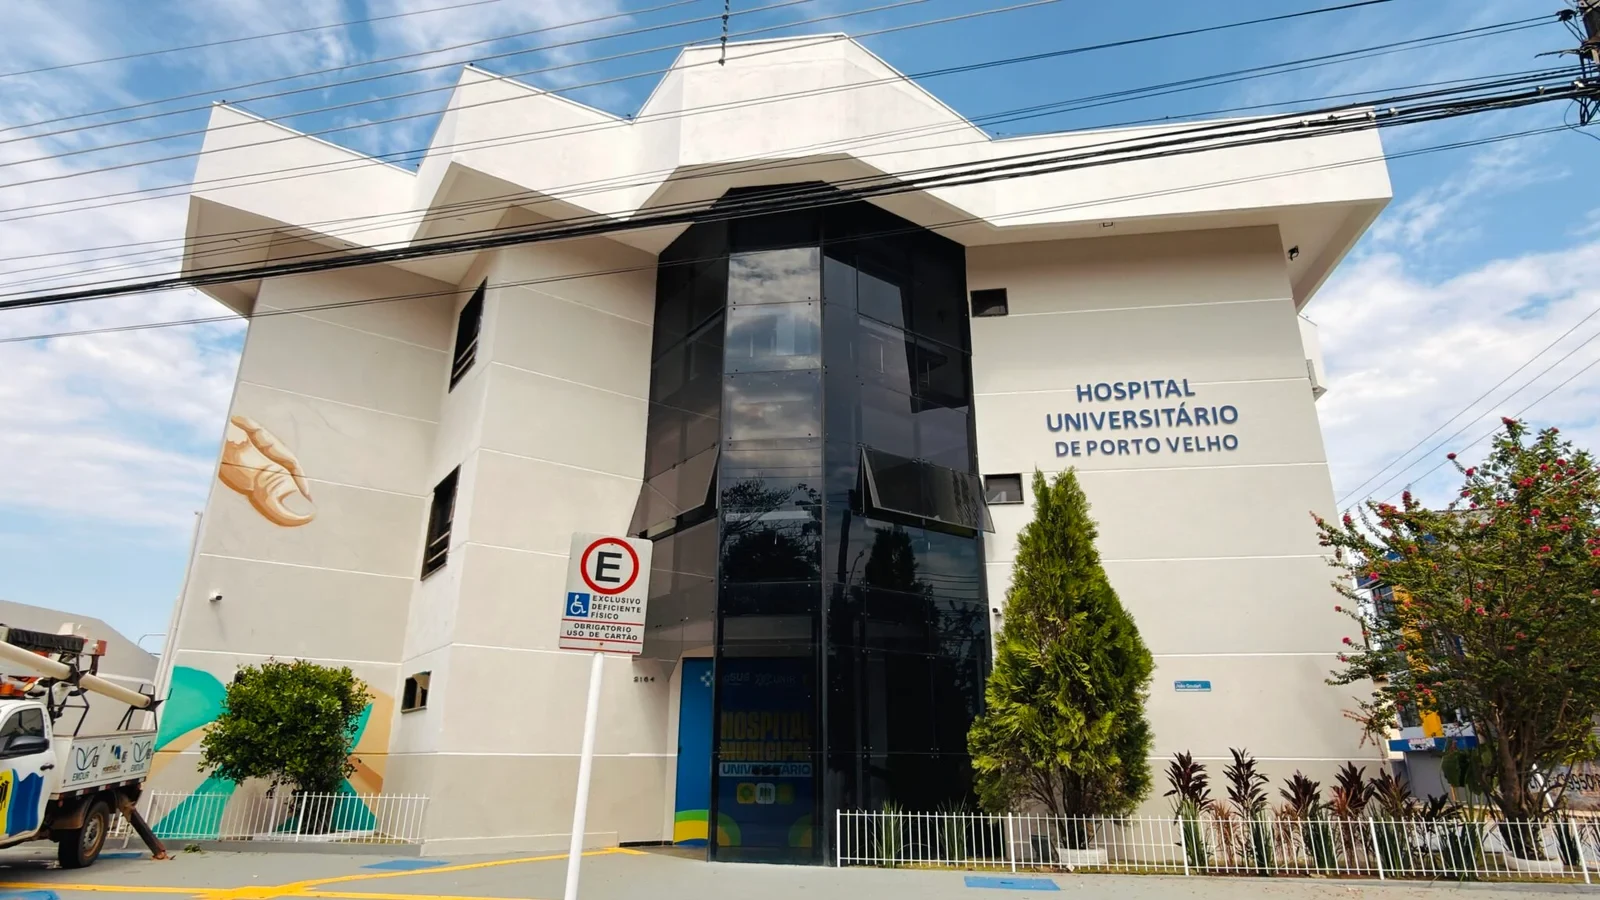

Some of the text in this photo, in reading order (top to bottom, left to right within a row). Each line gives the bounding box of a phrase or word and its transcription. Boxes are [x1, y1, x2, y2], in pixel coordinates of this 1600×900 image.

[1076, 379, 1195, 402] HOSPITAL
[1046, 402, 1238, 432] UNIVERSITÁRIO
[1055, 434, 1238, 457] DE PORTO VELHO
[595, 551, 622, 583] E
[591, 604, 641, 613] DEFICIENTE
[592, 595, 641, 604] EXCLUSIVO
[590, 611, 619, 619] FÍSICO
[721, 711, 812, 740] HOSPITAL
[722, 763, 811, 775] UNIVTÁRIO
